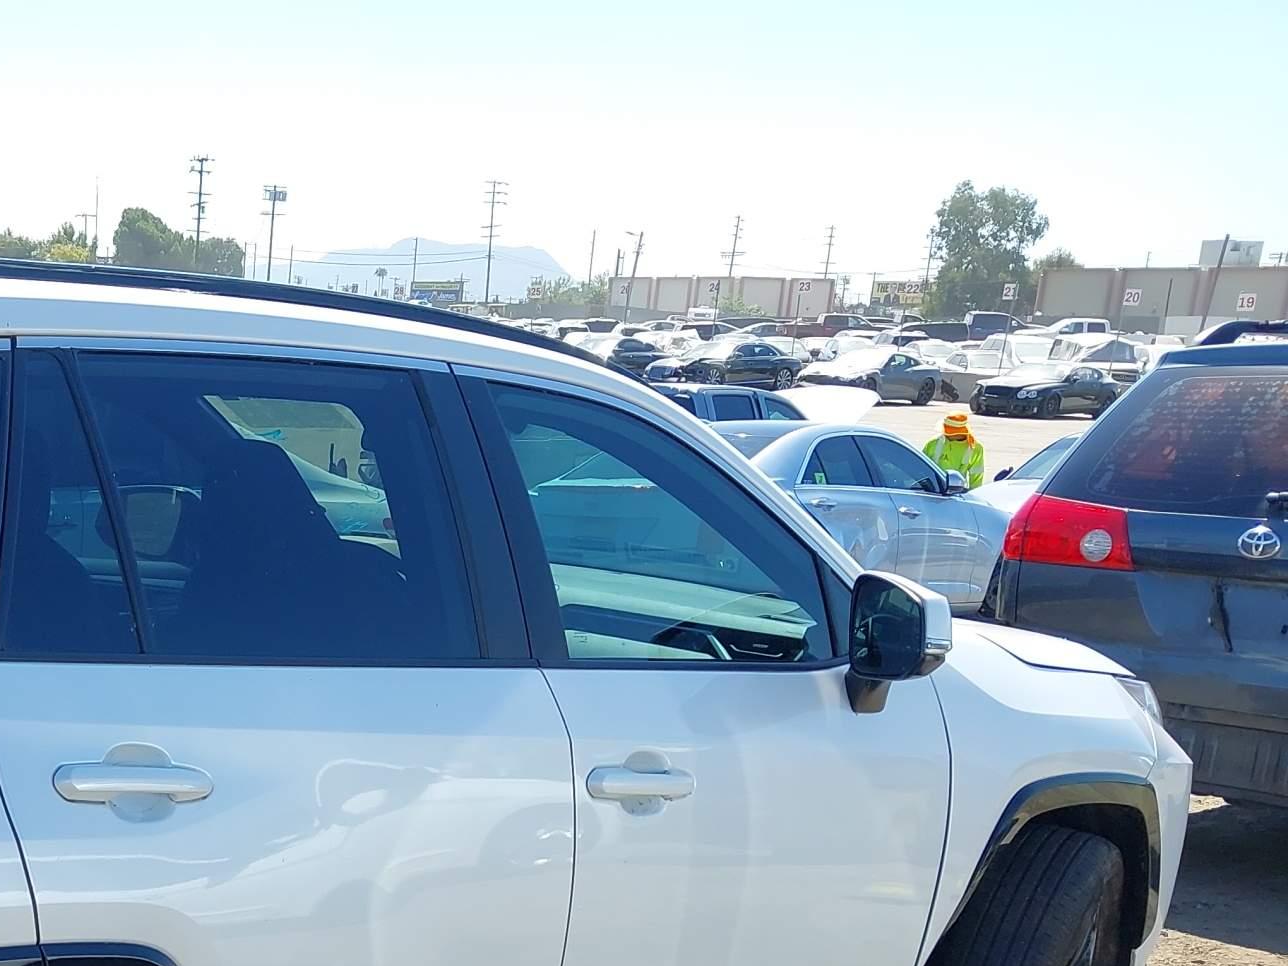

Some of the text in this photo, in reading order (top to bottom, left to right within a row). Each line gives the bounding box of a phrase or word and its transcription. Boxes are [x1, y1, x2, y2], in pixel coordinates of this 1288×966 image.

[531, 287, 541, 296] 25
[799, 281, 811, 292] 23
[906, 283, 920, 294] 22
[1124, 291, 1140, 303] 20
[1238, 296, 1255, 308] 19
